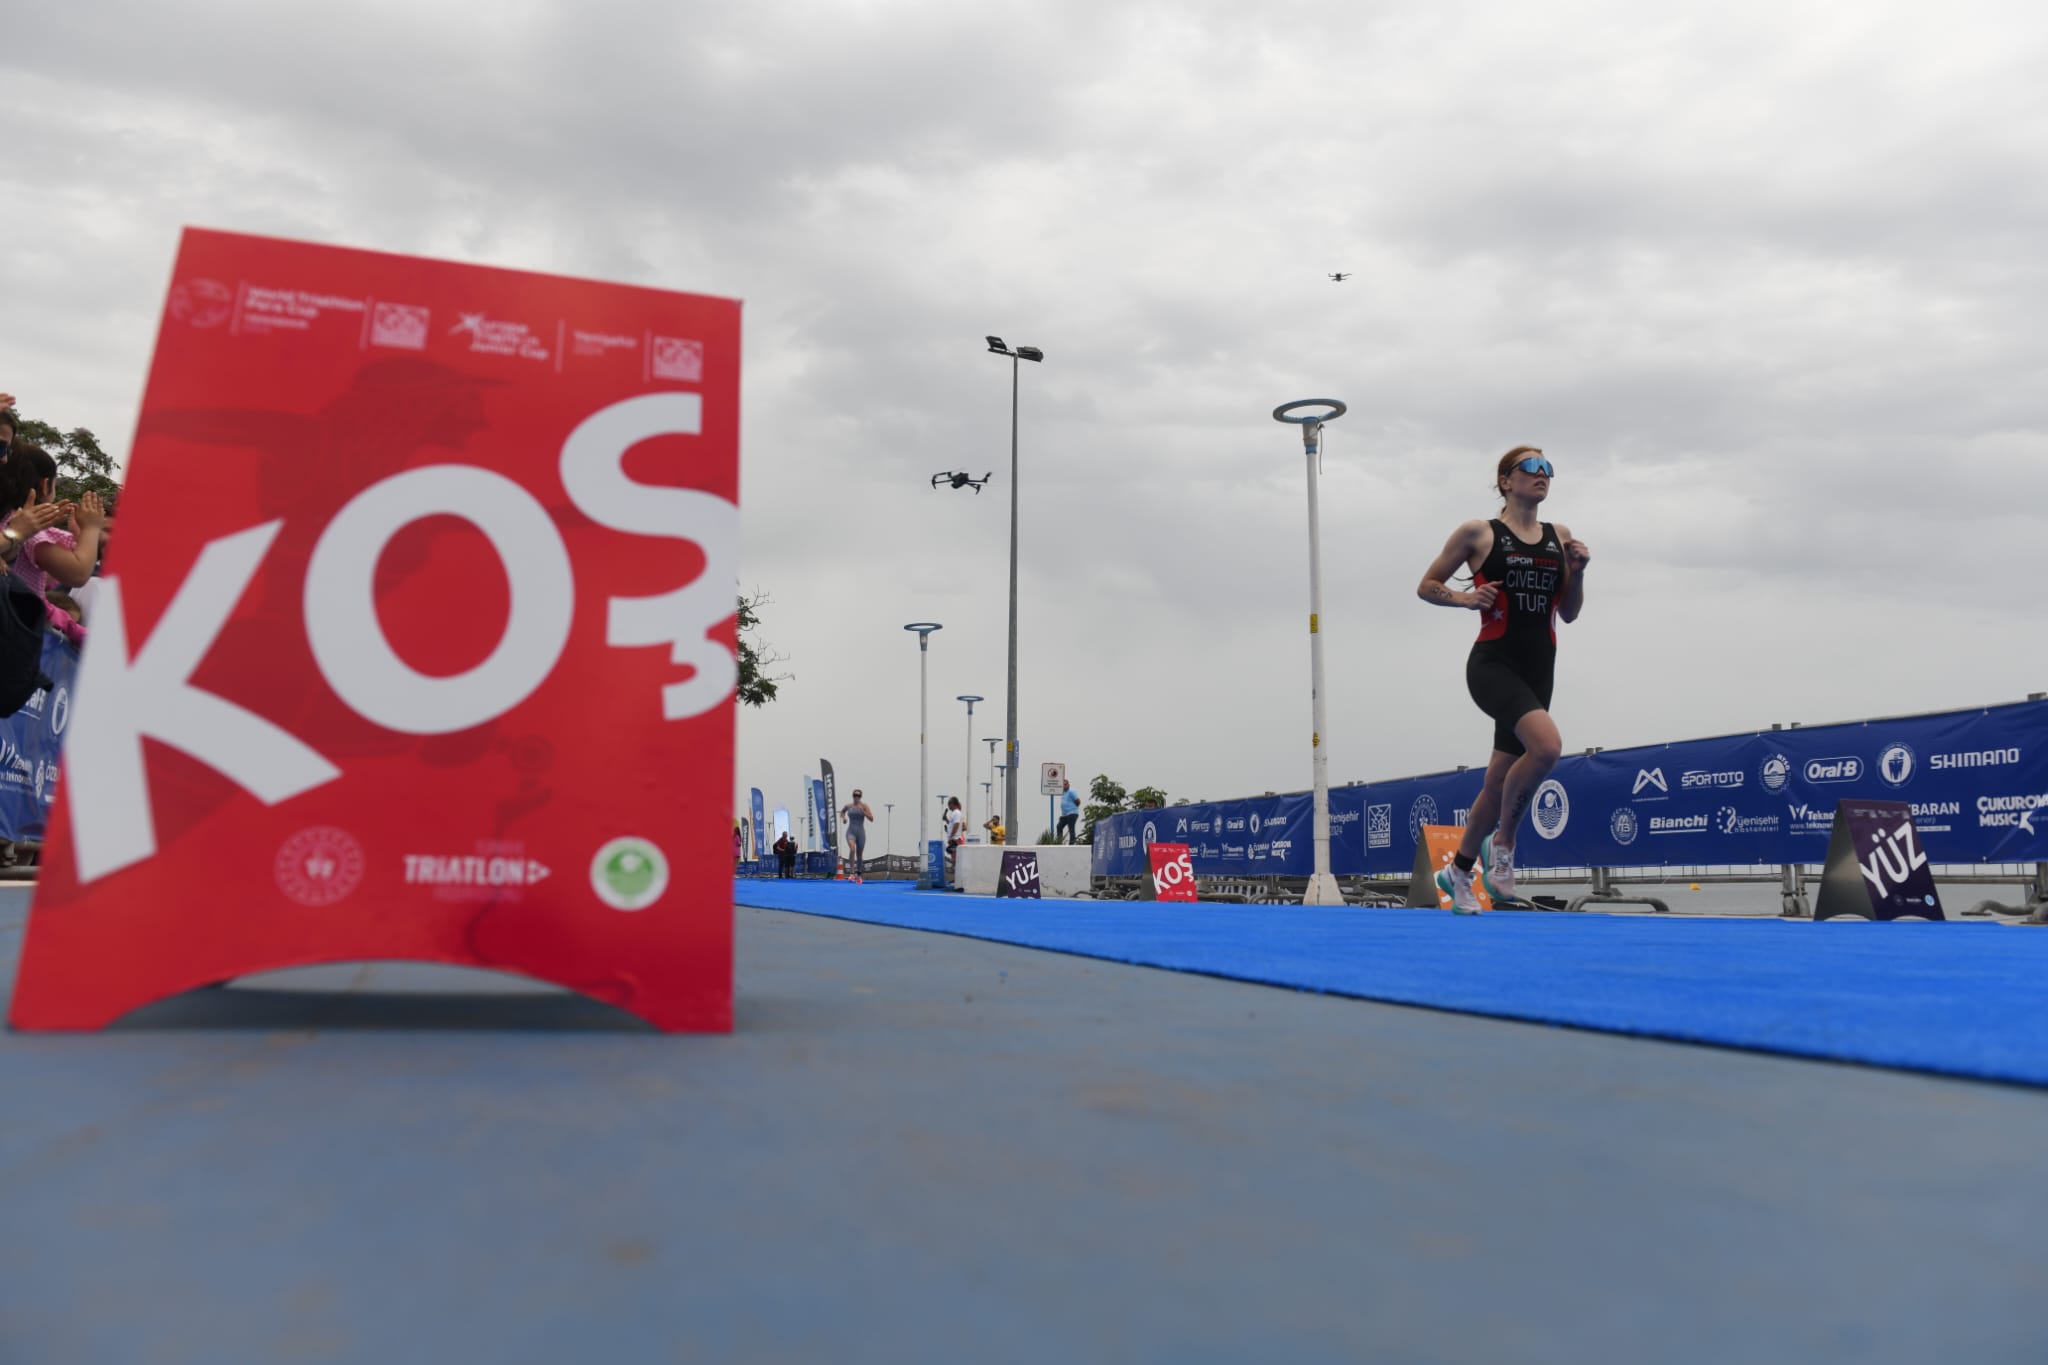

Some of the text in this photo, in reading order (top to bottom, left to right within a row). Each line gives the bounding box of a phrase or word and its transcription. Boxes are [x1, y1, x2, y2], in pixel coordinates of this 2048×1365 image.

[1515, 592, 1548, 614] TUR
[64, 392, 739, 885] KOŞ
[1807, 760, 1858, 779] Oral-B
[1930, 747, 2020, 770] SHIMANO
[1650, 814, 1708, 829] Bianchi
[1979, 812, 2019, 827] MUSIC
[1860, 821, 1927, 900] YÜZ
[1005, 861, 1039, 891] YÜZ
[1152, 853, 1195, 895] KOŞ
